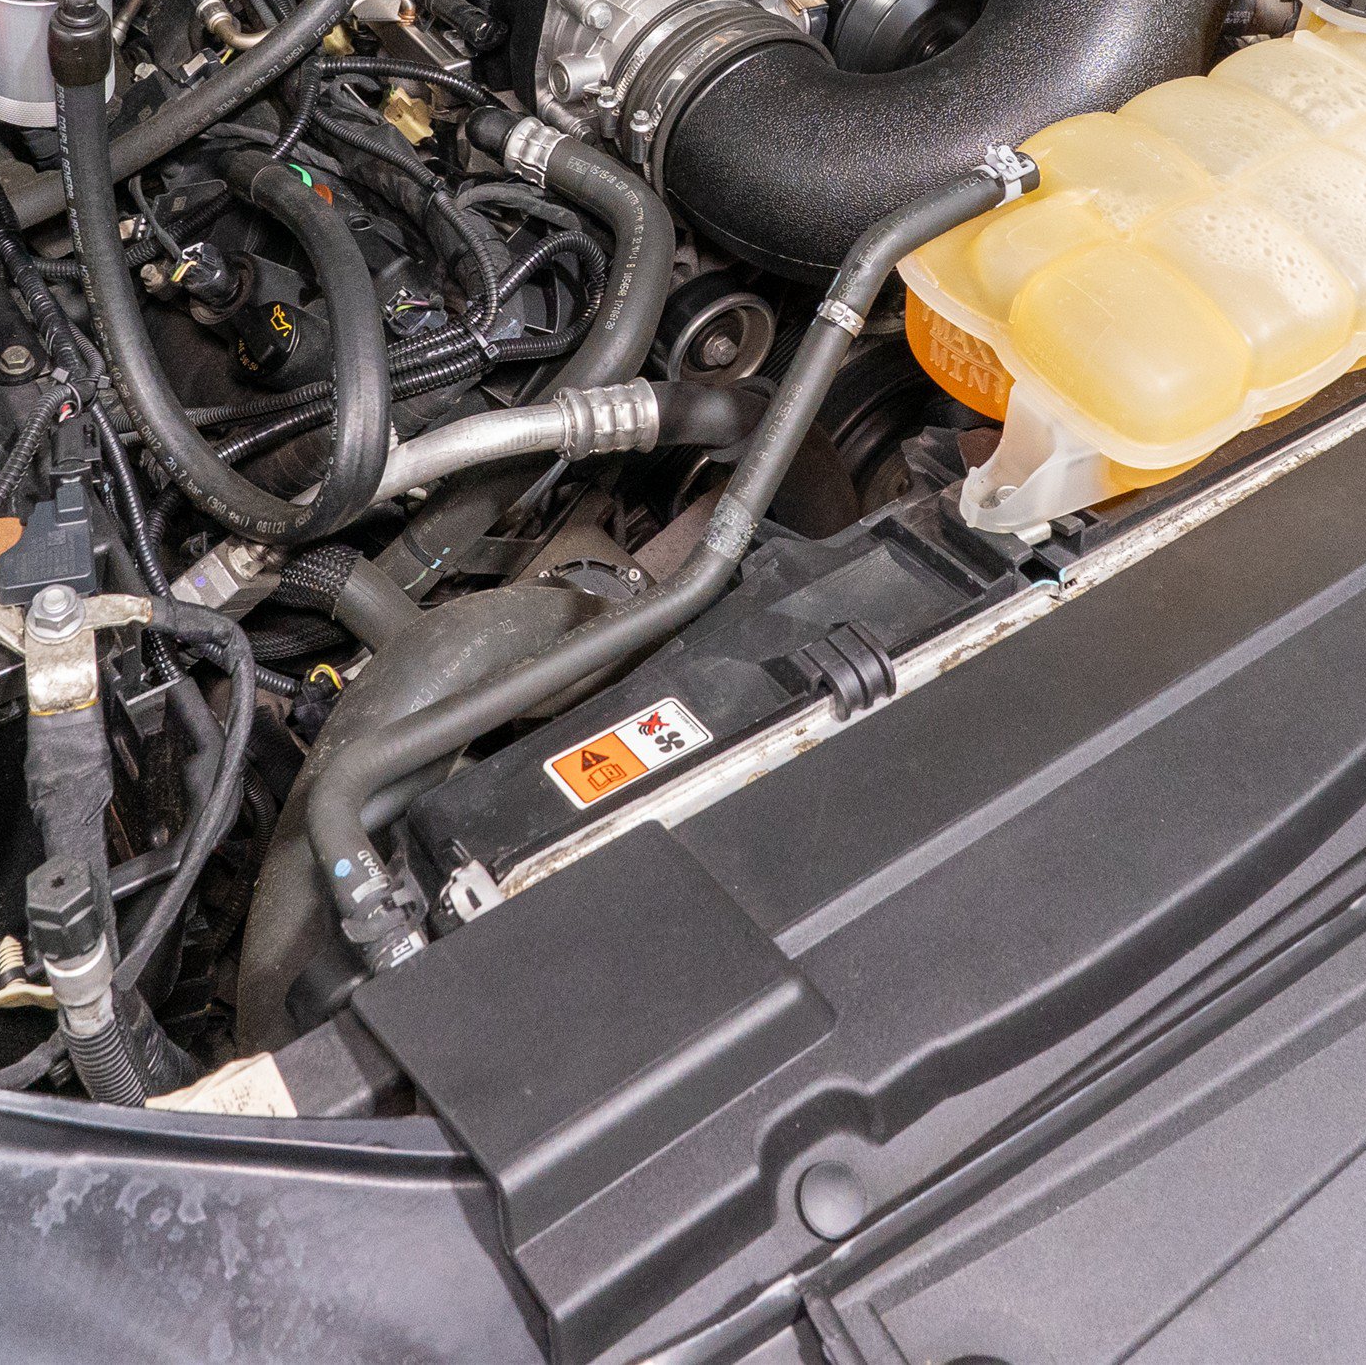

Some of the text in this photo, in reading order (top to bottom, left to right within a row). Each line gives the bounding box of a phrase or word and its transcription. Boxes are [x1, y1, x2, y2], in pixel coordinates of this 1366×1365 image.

[280, 42, 306, 66] MSHA
[57, 114, 70, 154] COUPLE
[62, 157, 75, 200] GENERAL
[69, 207, 83, 253] PURPOSE
[930, 339, 990, 394] MIN
[140, 424, 163, 451] DN12
